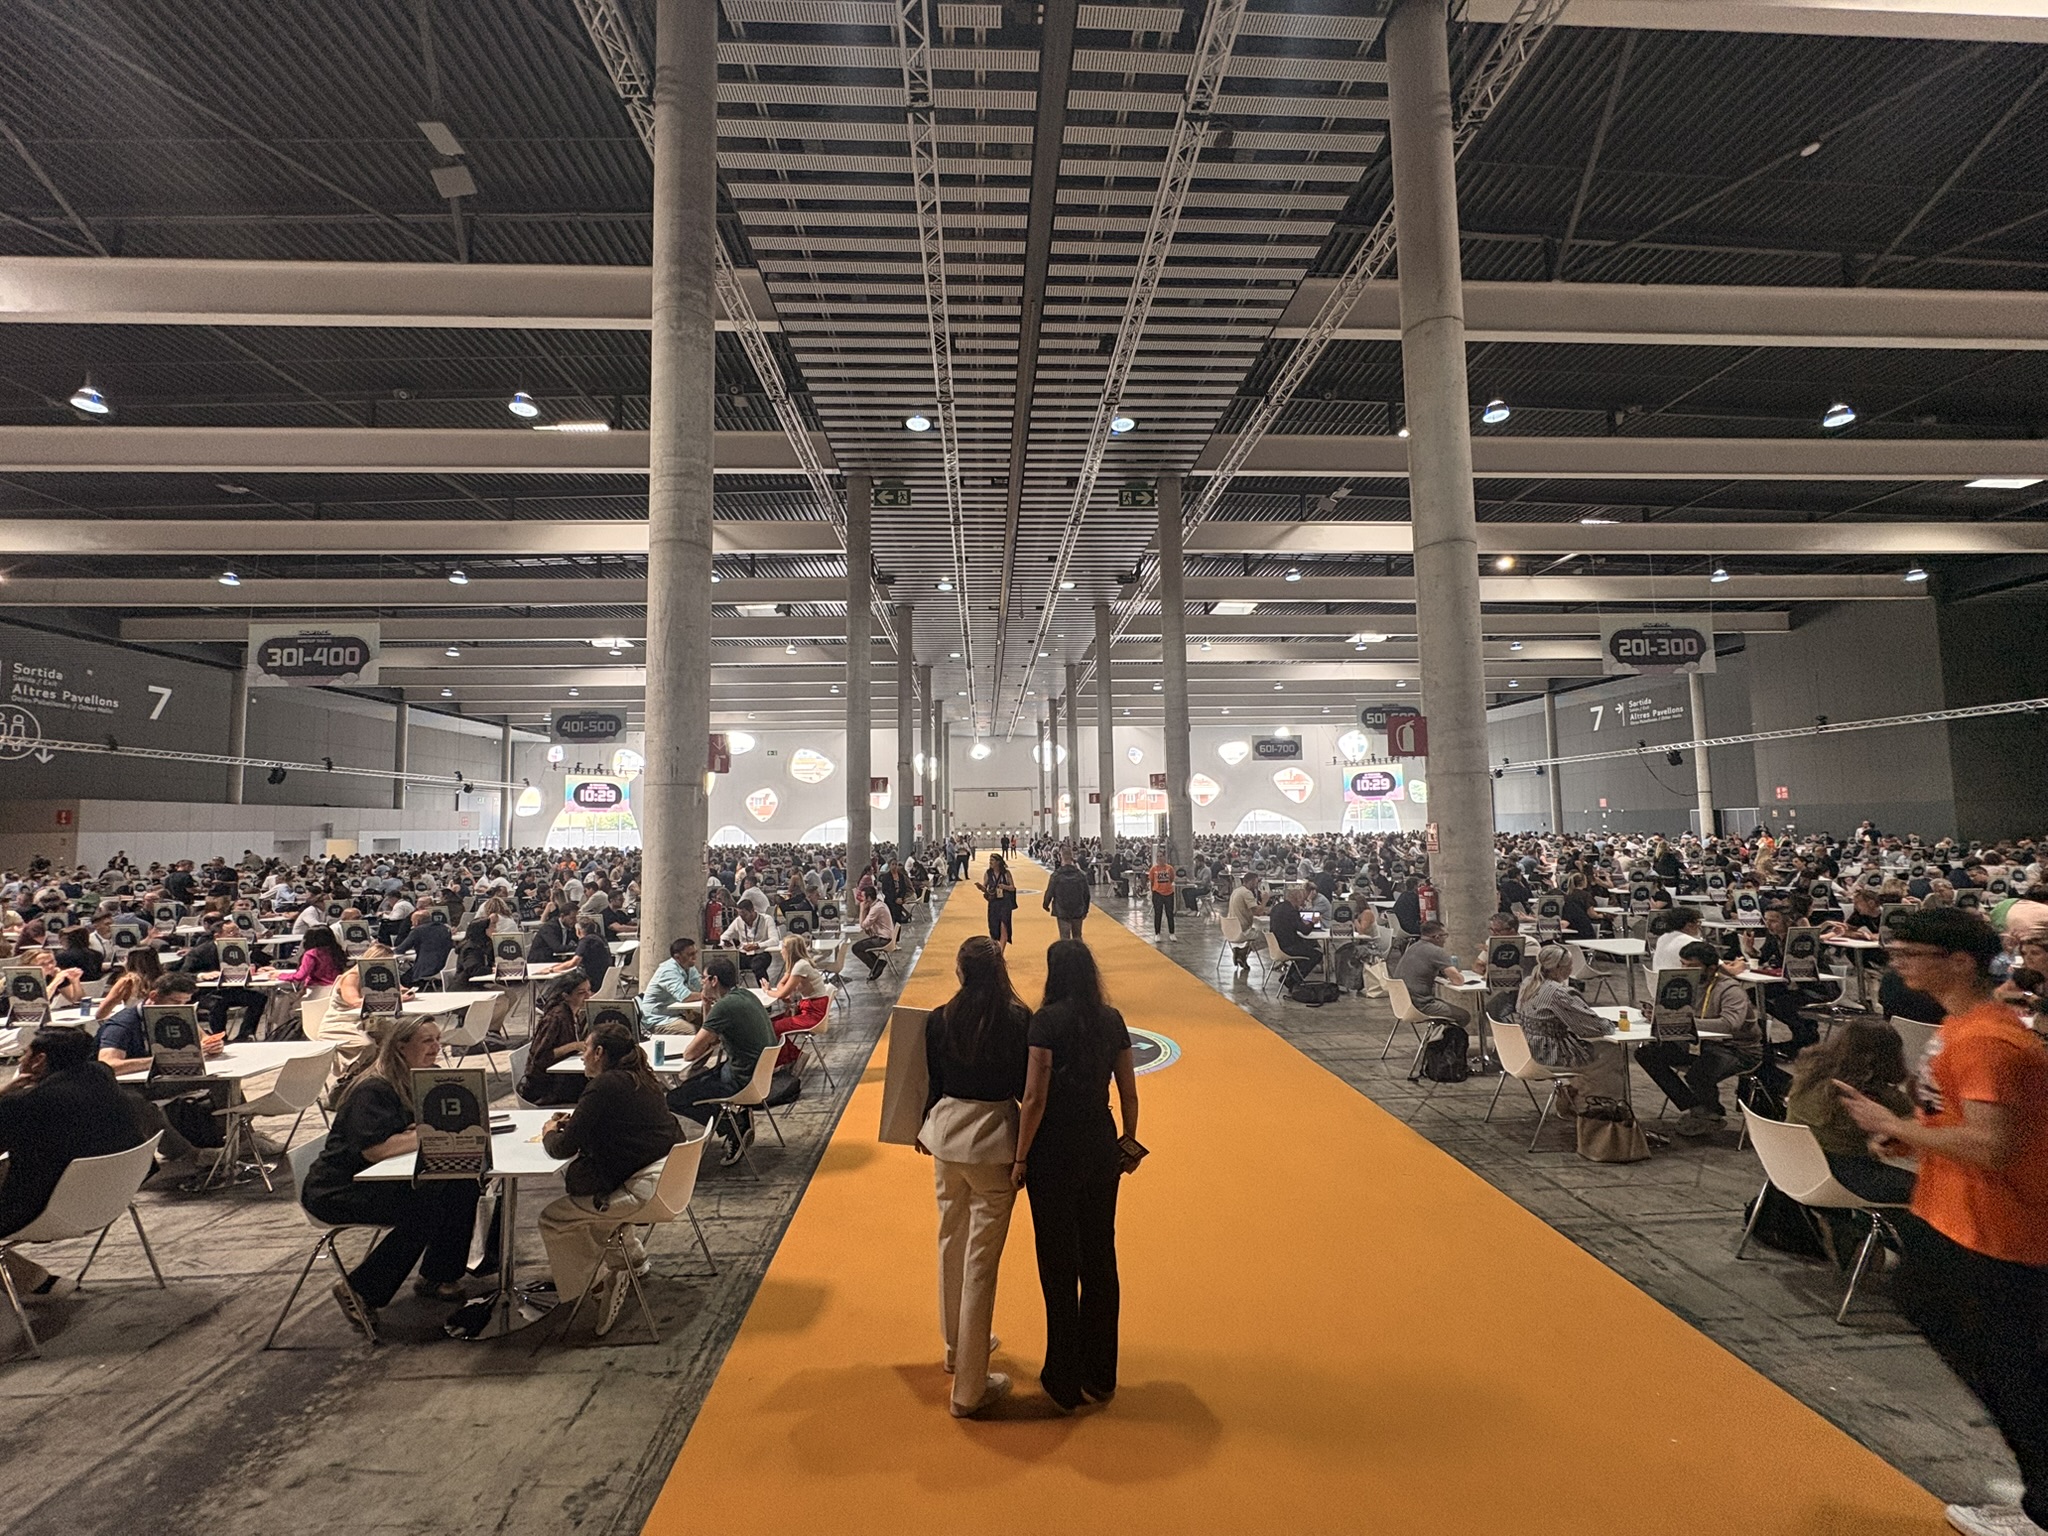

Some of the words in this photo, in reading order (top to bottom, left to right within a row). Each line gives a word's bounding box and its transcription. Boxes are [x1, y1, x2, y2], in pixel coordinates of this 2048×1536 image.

[1618, 638, 1698, 656] 201-300
[266, 646, 360, 667] 301-400
[13, 662, 64, 680] Sortida
[12, 683, 57, 699] Altres
[62, 690, 120, 708] Pavellons
[148, 685, 172, 720] 7
[1628, 698, 1652, 708] Sortida
[1590, 705, 1604, 732] 7
[1630, 713, 1650, 721] Altres
[1652, 706, 1684, 717] Pavellons
[562, 720, 616, 732] 401-500
[1260, 744, 1295, 754] 601-700
[1356, 778, 1391, 792] 10:29
[580, 790, 616, 802] 10:29
[229, 951, 238, 960] 41
[503, 945, 517, 954] 40
[1498, 950, 1515, 960] 127
[370, 974, 388, 983] 38
[18, 982, 34, 992] 37
[1666, 986, 1688, 999] 126
[166, 1025, 181, 1038] 15
[441, 1098, 462, 1116] 13
